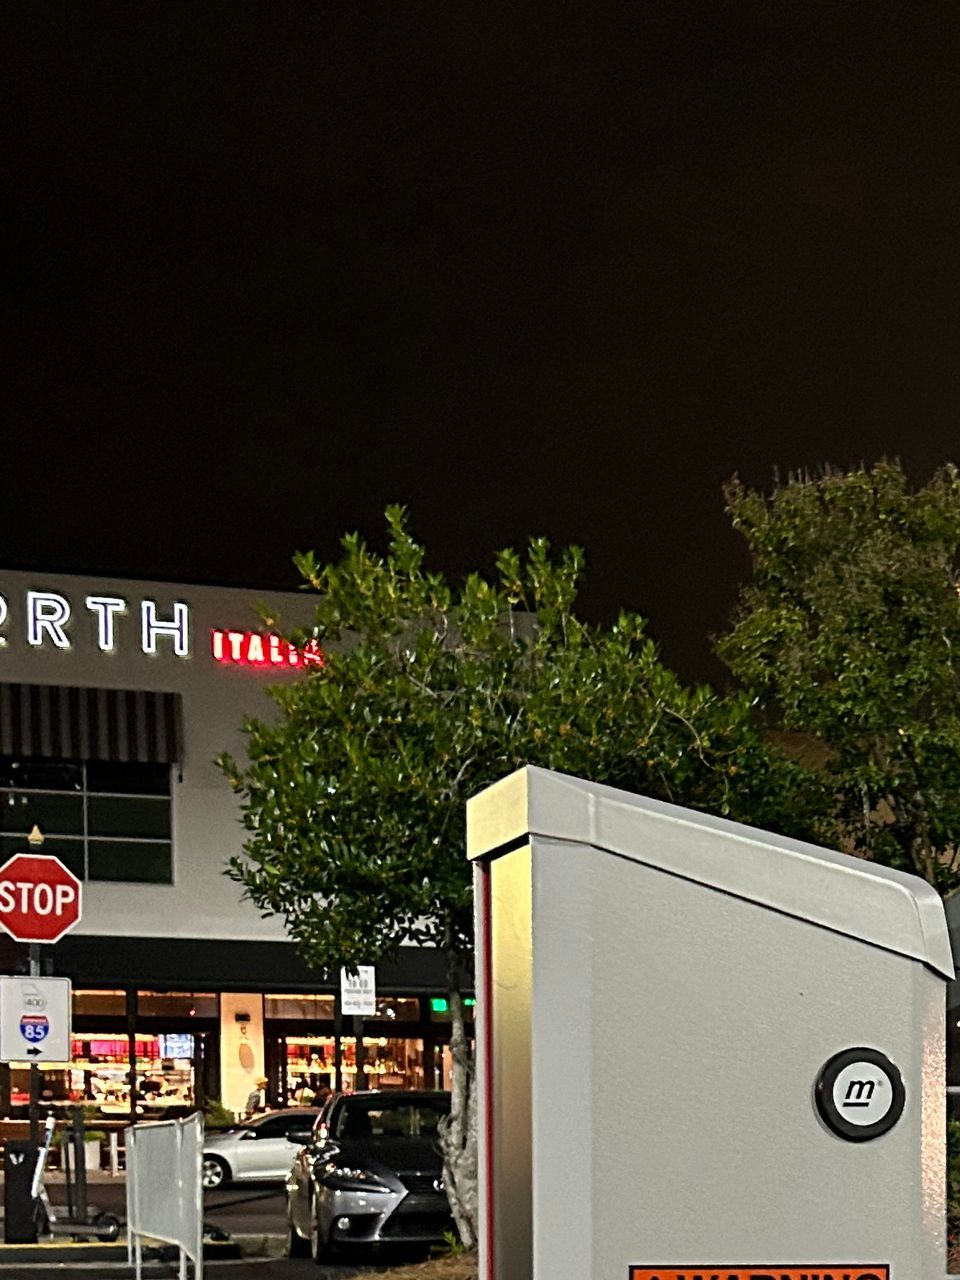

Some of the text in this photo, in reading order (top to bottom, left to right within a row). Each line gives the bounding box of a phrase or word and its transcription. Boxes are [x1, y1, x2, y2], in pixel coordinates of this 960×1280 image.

[0, 591, 189, 656] RTH
[0, 881, 75, 916] STOP
[24, 1024, 45, 1039] 85
